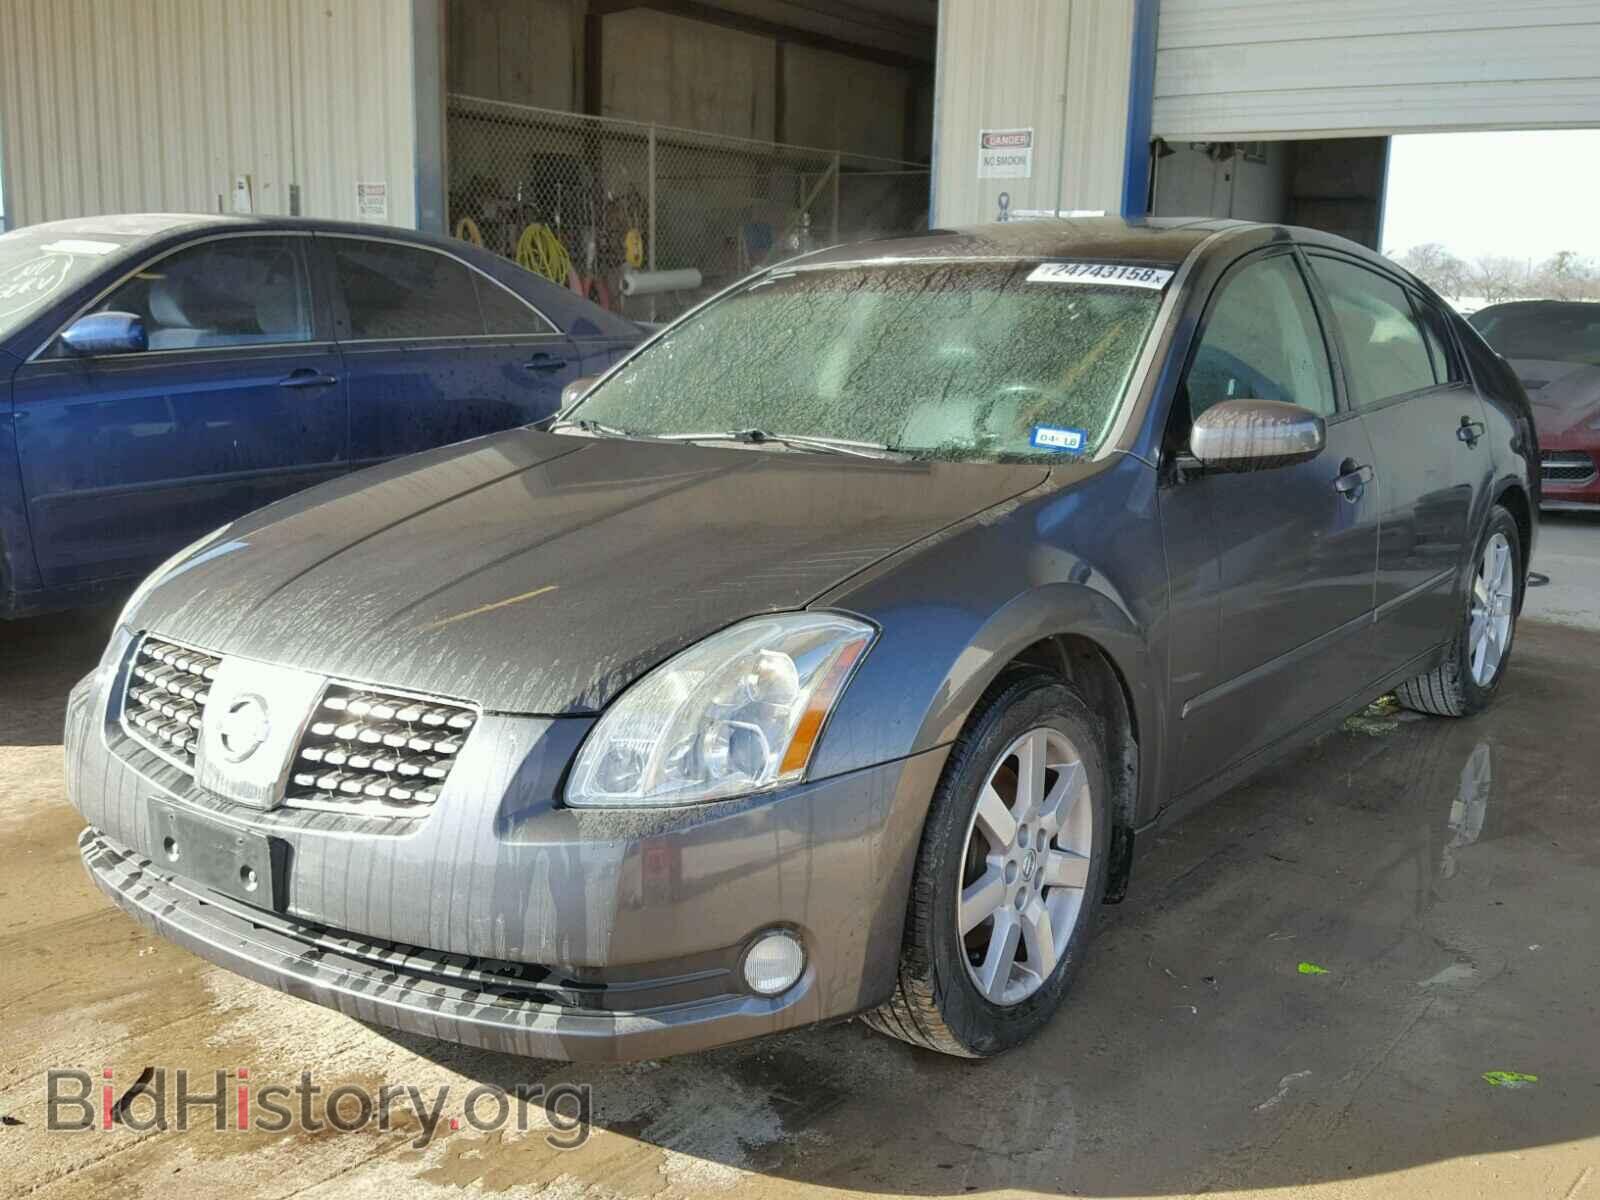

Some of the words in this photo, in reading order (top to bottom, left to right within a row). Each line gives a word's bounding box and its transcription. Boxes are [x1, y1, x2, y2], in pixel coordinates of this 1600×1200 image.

[989, 135, 1026, 146] DANGER
[984, 156, 996, 167] NO
[1051, 264, 1156, 282] 24743158
